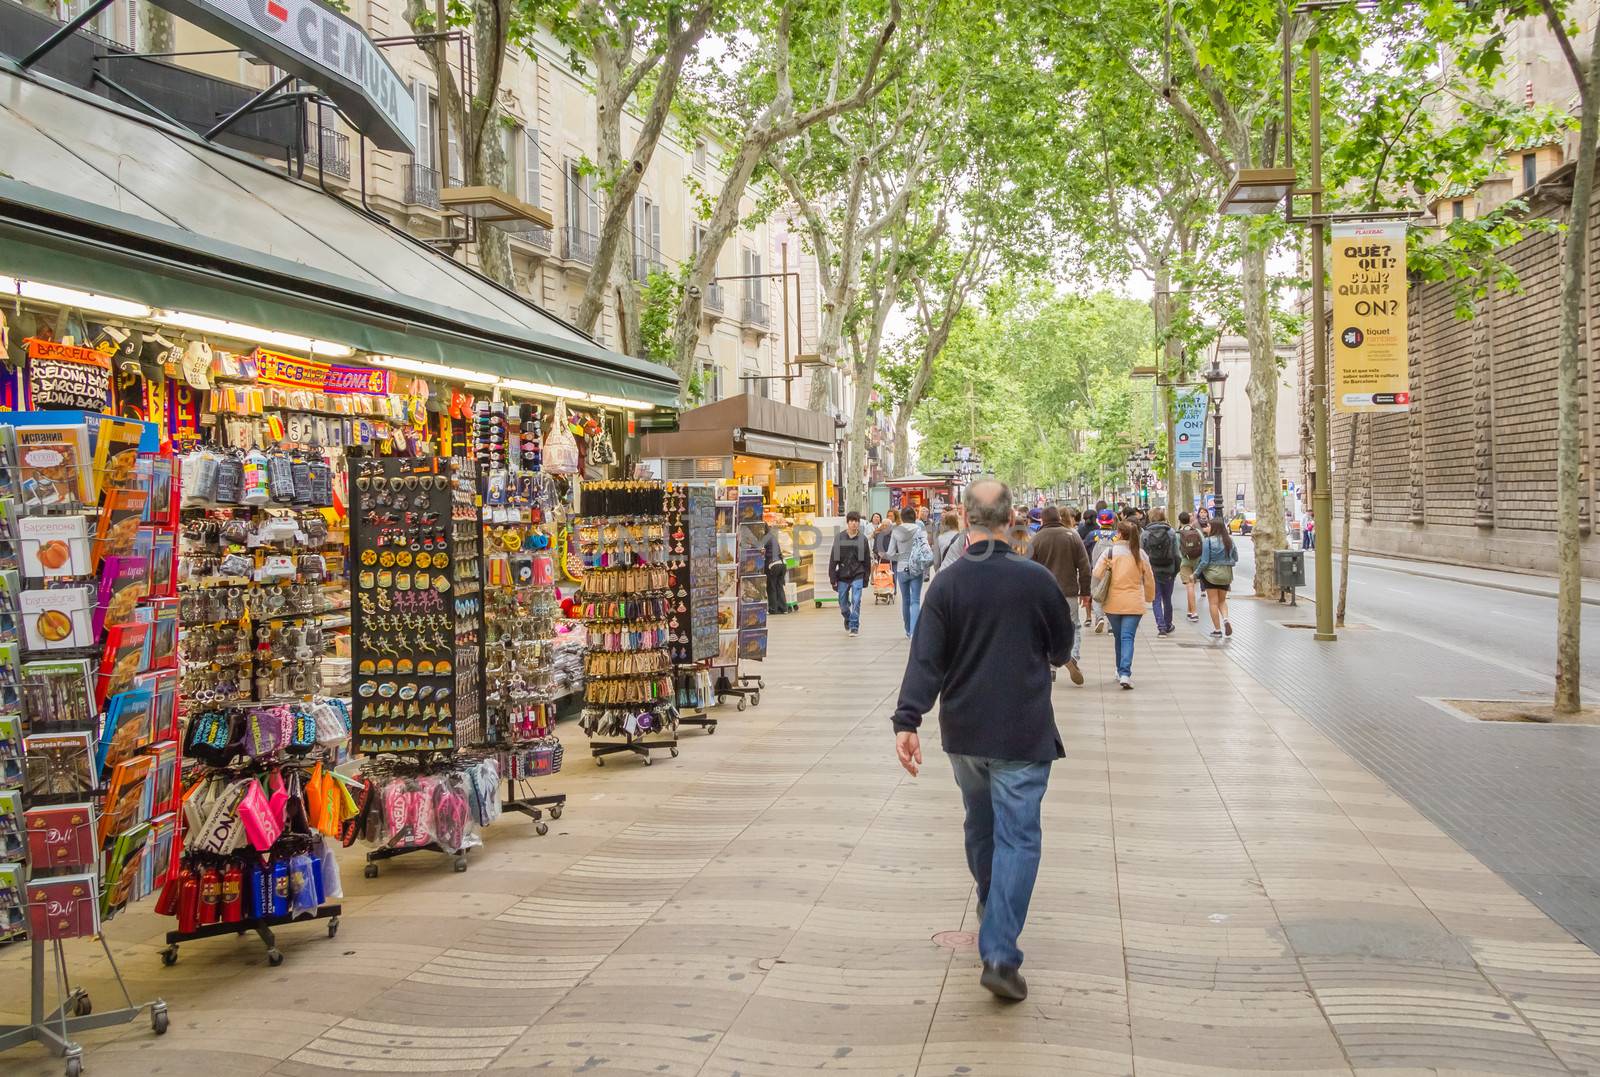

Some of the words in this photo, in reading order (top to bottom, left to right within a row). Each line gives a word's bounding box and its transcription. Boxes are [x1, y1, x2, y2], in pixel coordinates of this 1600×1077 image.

[1344, 245, 1391, 258] QUÈ?
[1358, 258, 1397, 271] QUI?
[1351, 272, 1390, 284] COM?
[1338, 284, 1390, 296] QUAN?
[1355, 300, 1400, 316] ON?
[1366, 328, 1390, 336] tiquet
[84, 416, 101, 425] TRIA
[1184, 421, 1203, 429] ON?
